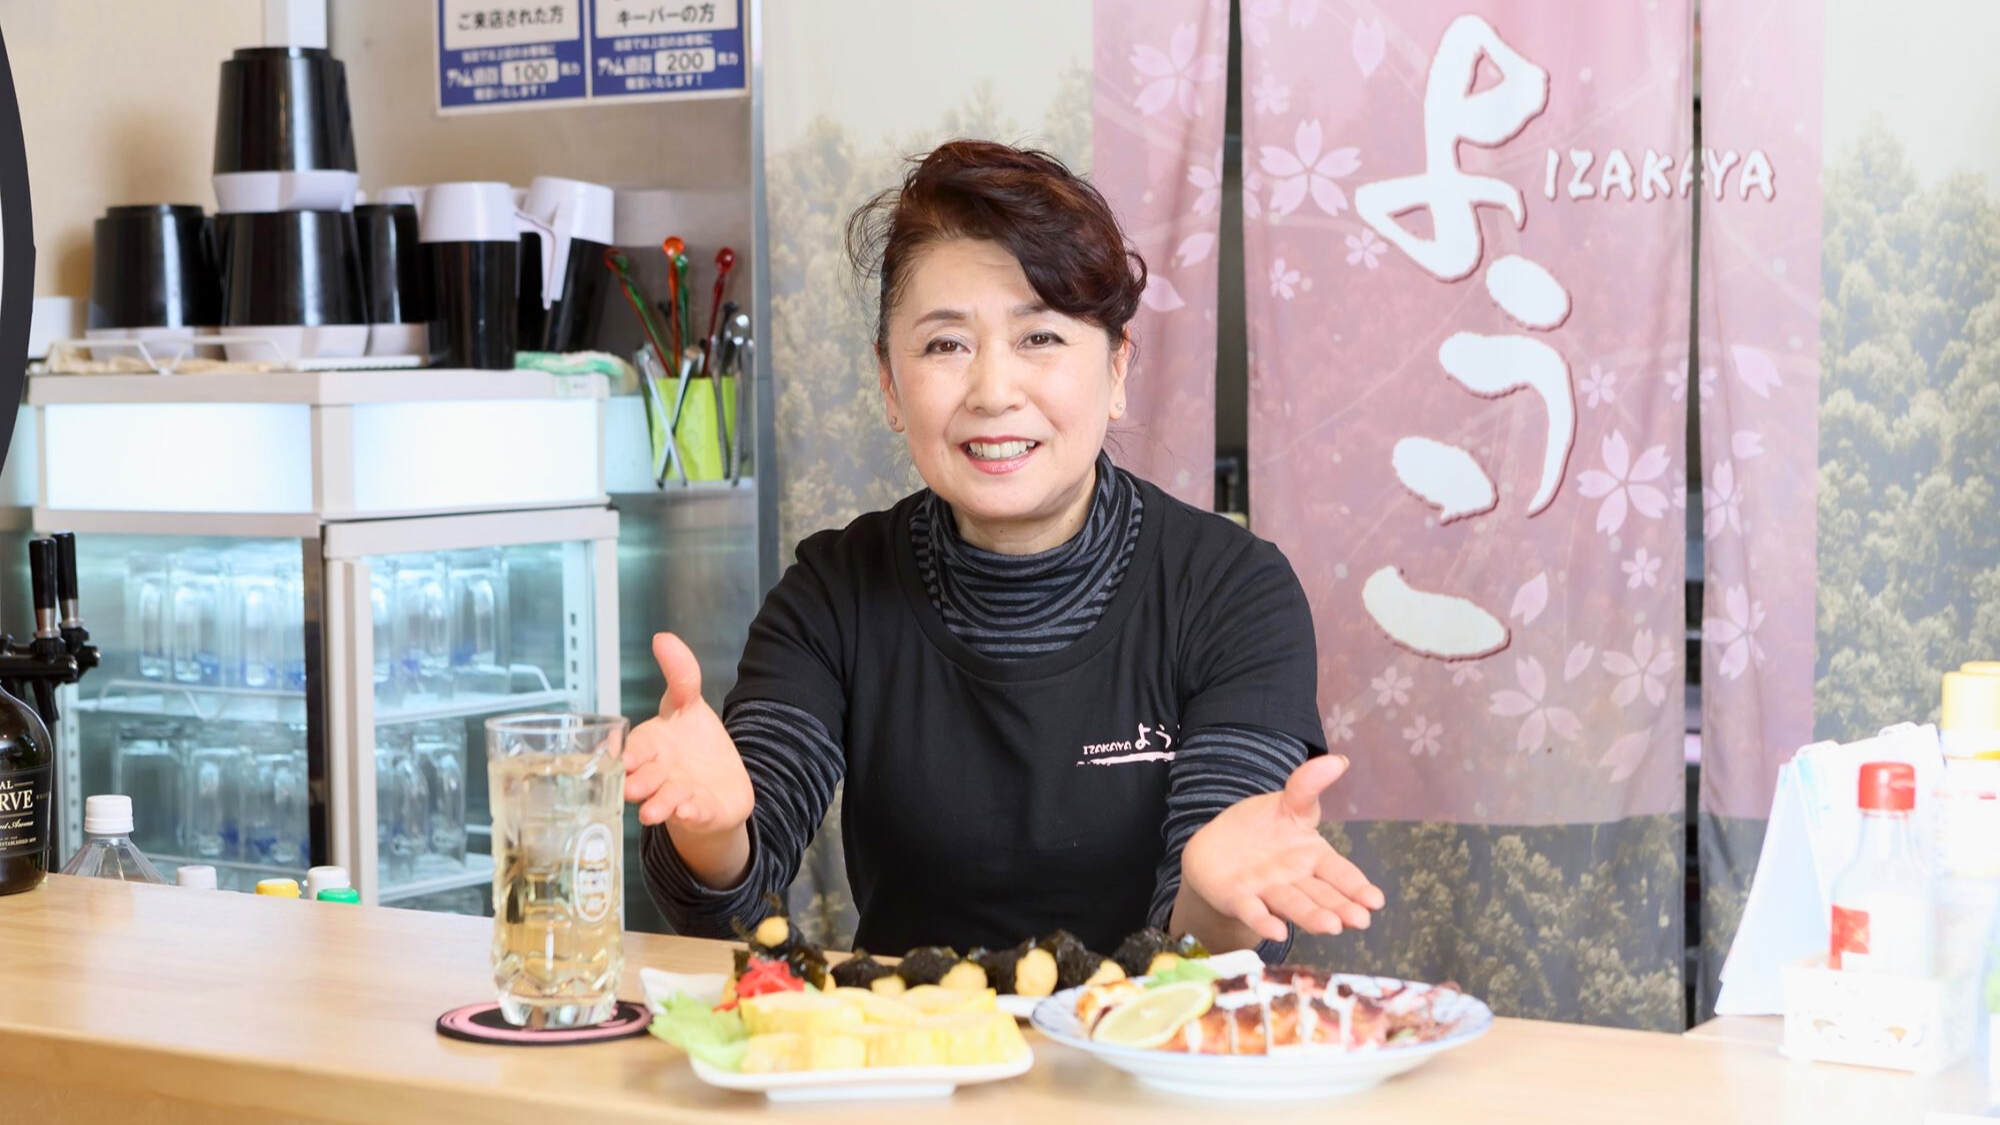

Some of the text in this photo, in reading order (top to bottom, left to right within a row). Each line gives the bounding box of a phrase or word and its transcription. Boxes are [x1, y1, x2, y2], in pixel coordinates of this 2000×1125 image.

[458, 5, 564, 30] ご来店された方
[512, 62, 549, 83] 100
[667, 52, 704, 72] 200
[1544, 148, 1776, 202] IZAKAYA
[1083, 722, 1181, 755] IZAKAYA よう
[0, 789, 34, 811] RVE
